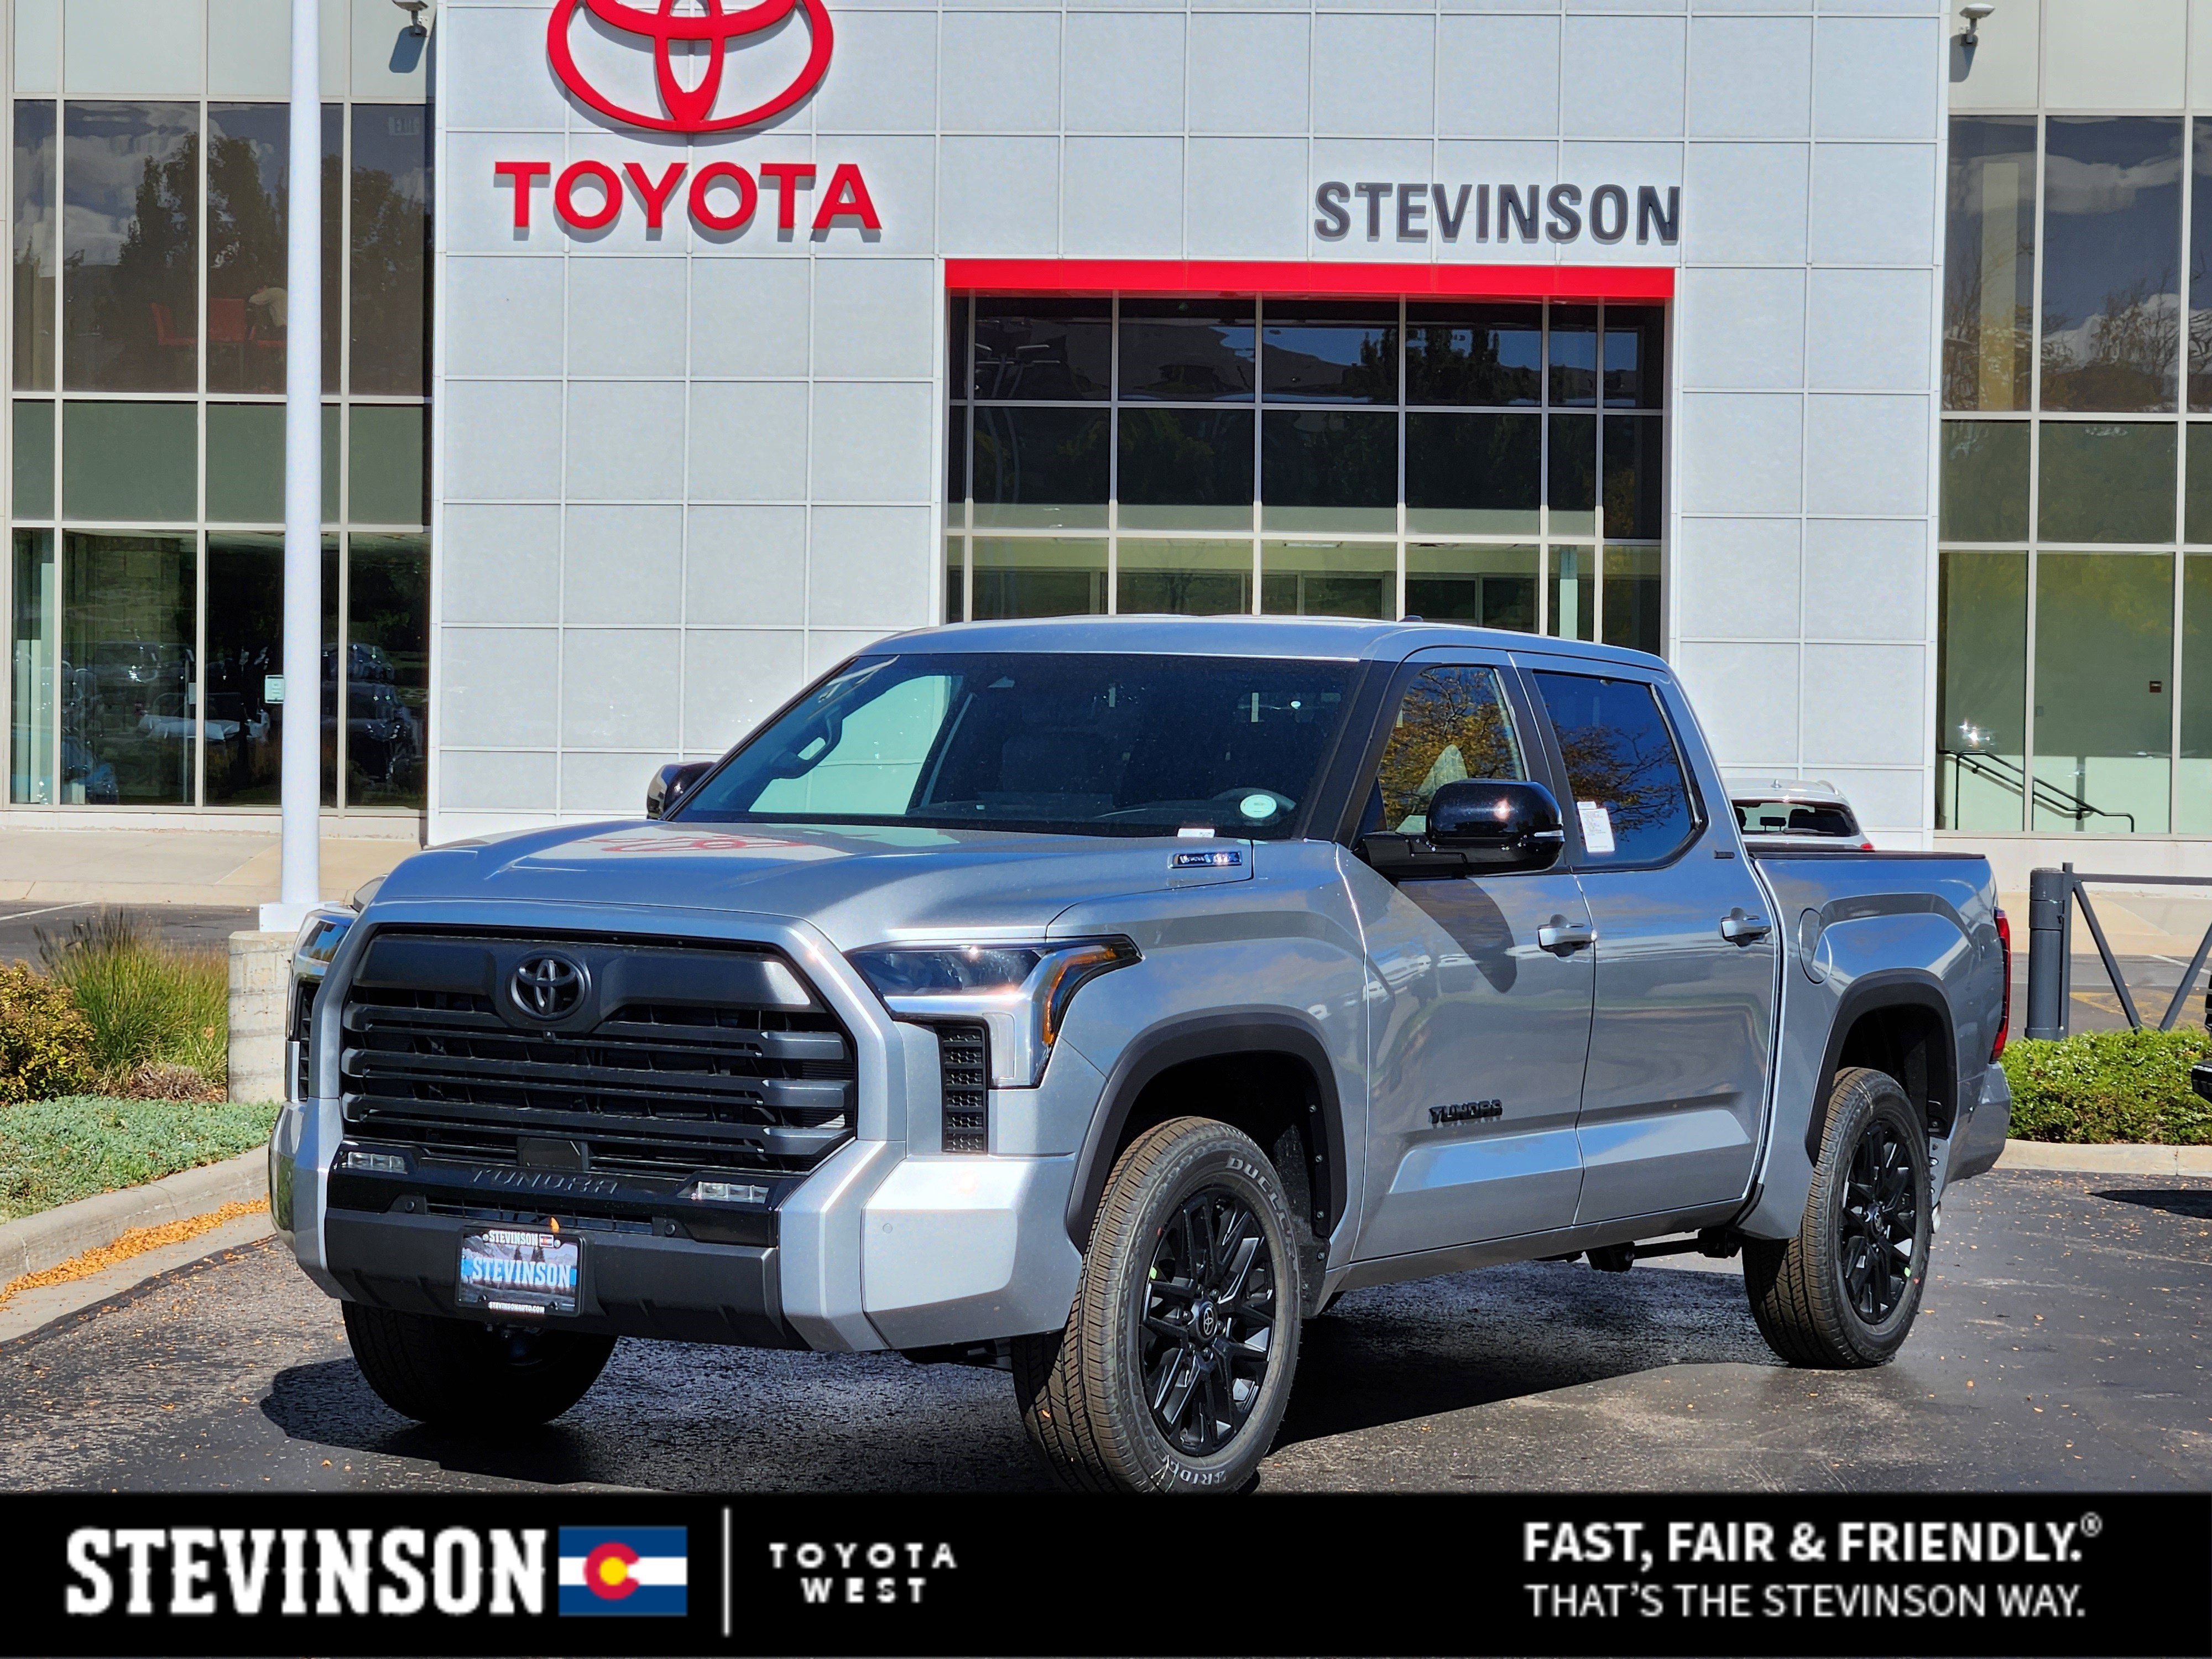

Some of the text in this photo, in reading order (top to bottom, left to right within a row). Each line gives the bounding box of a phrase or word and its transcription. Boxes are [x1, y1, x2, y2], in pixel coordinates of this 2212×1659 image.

[494, 160, 883, 231] TOYOTA
[1314, 181, 1681, 245] STEVINSON
[488, 1229, 539, 1246] STEVINSON
[472, 1256, 572, 1288] STEVINSON
[488, 1301, 545, 1314] STEVINSONAUTO.COM
